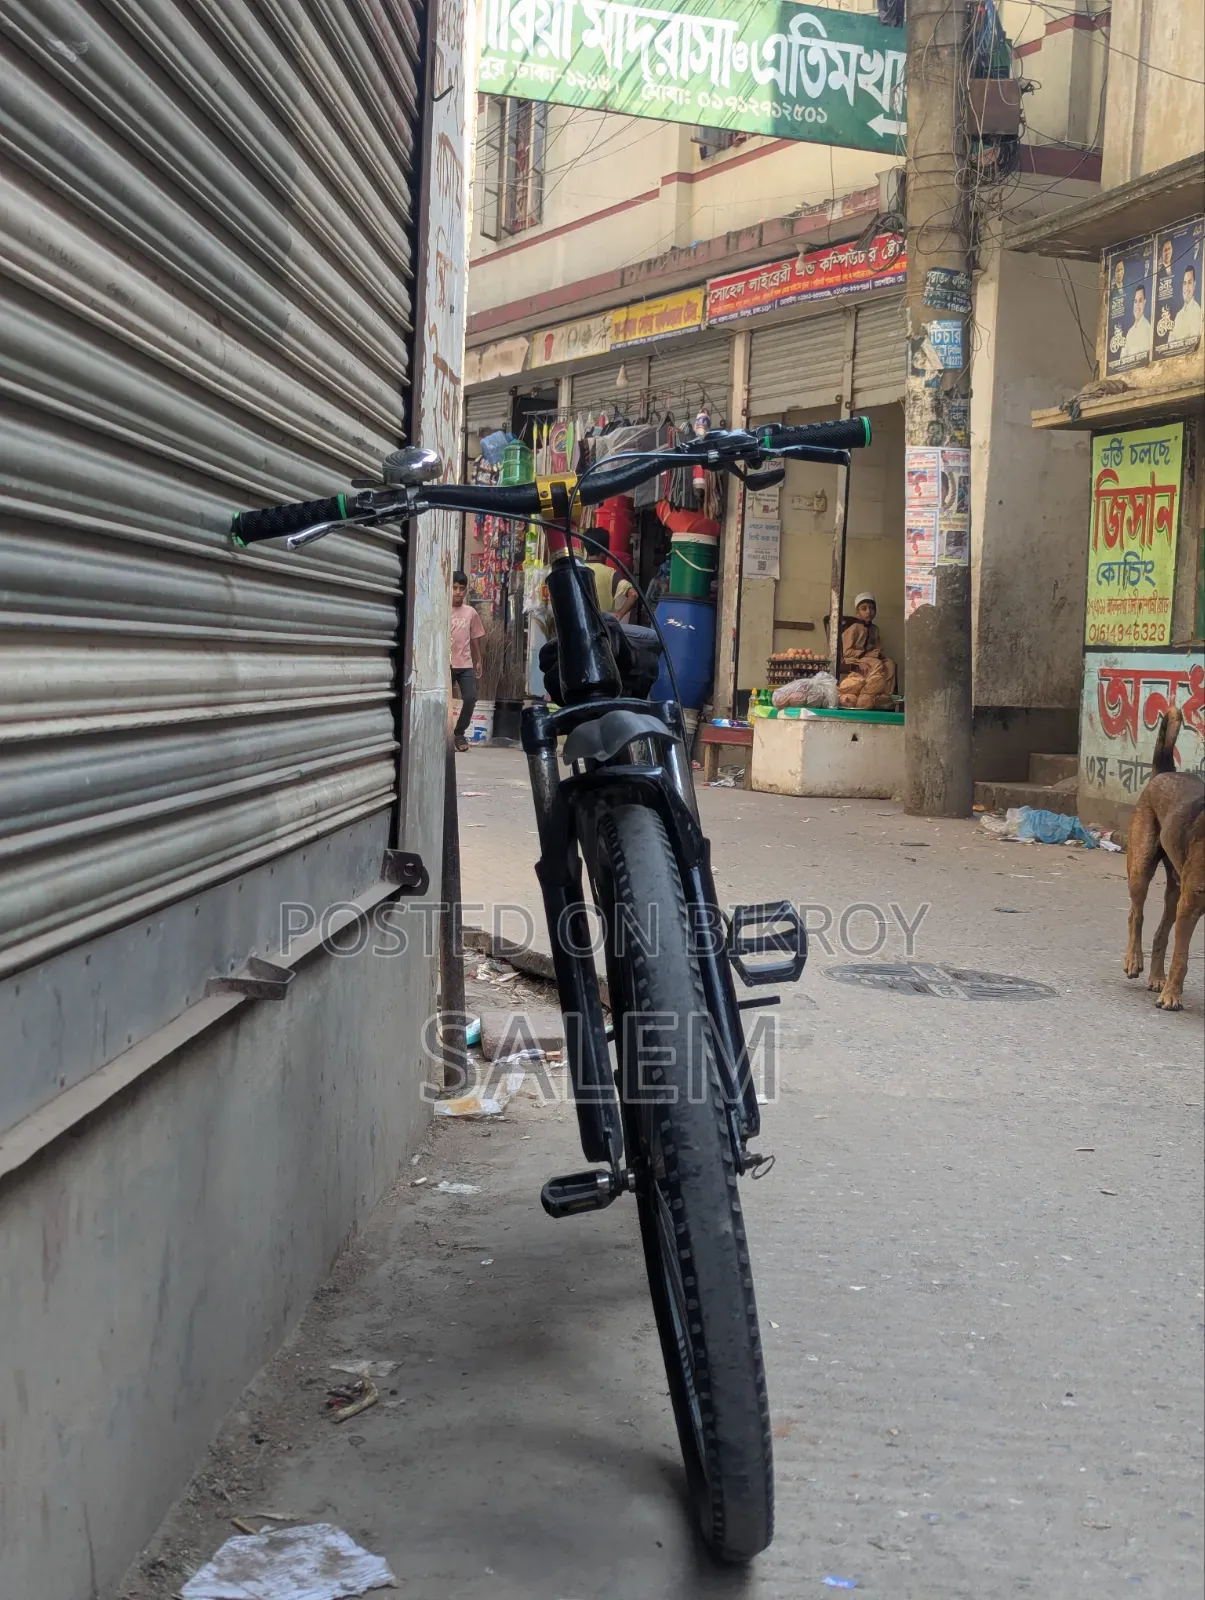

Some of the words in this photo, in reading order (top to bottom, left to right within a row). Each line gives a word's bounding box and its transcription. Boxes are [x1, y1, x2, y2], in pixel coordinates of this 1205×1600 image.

[750, 12, 907, 115] এতিমখা
[709, 281, 746, 304] সোহেল
[1101, 437, 1125, 469] ভর্তি
[1128, 438, 1172, 466] চলছে
[1093, 468, 1177, 554] জিসান
[1096, 550, 1156, 590] কোচিং
